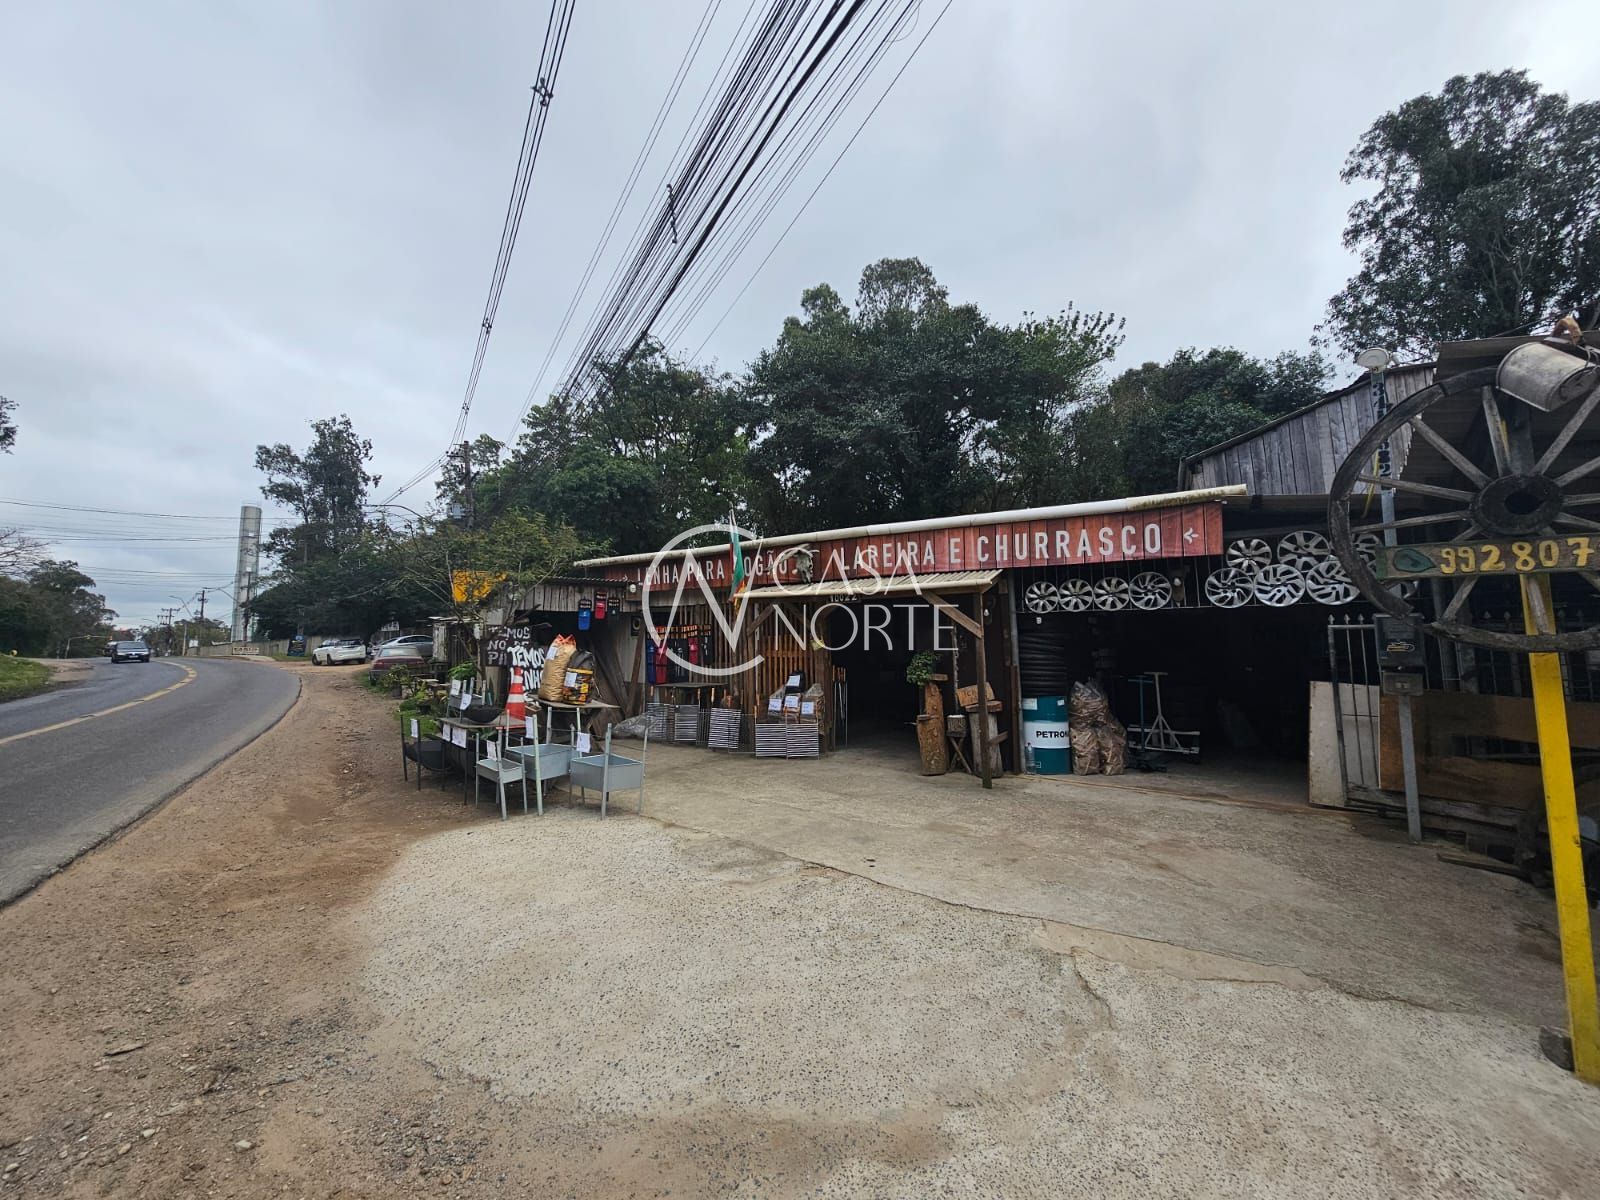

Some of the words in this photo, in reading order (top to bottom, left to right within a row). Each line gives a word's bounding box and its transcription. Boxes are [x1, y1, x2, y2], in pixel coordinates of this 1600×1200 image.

[637, 563, 680, 587] LENHA
[687, 559, 725, 581] PARA
[732, 550, 788, 579] OGÃO
[841, 540, 935, 571] LAREIRA
[950, 538, 961, 564] E
[976, 523, 1161, 562] CHURRASCO
[507, 645, 545, 668] TEMOS
